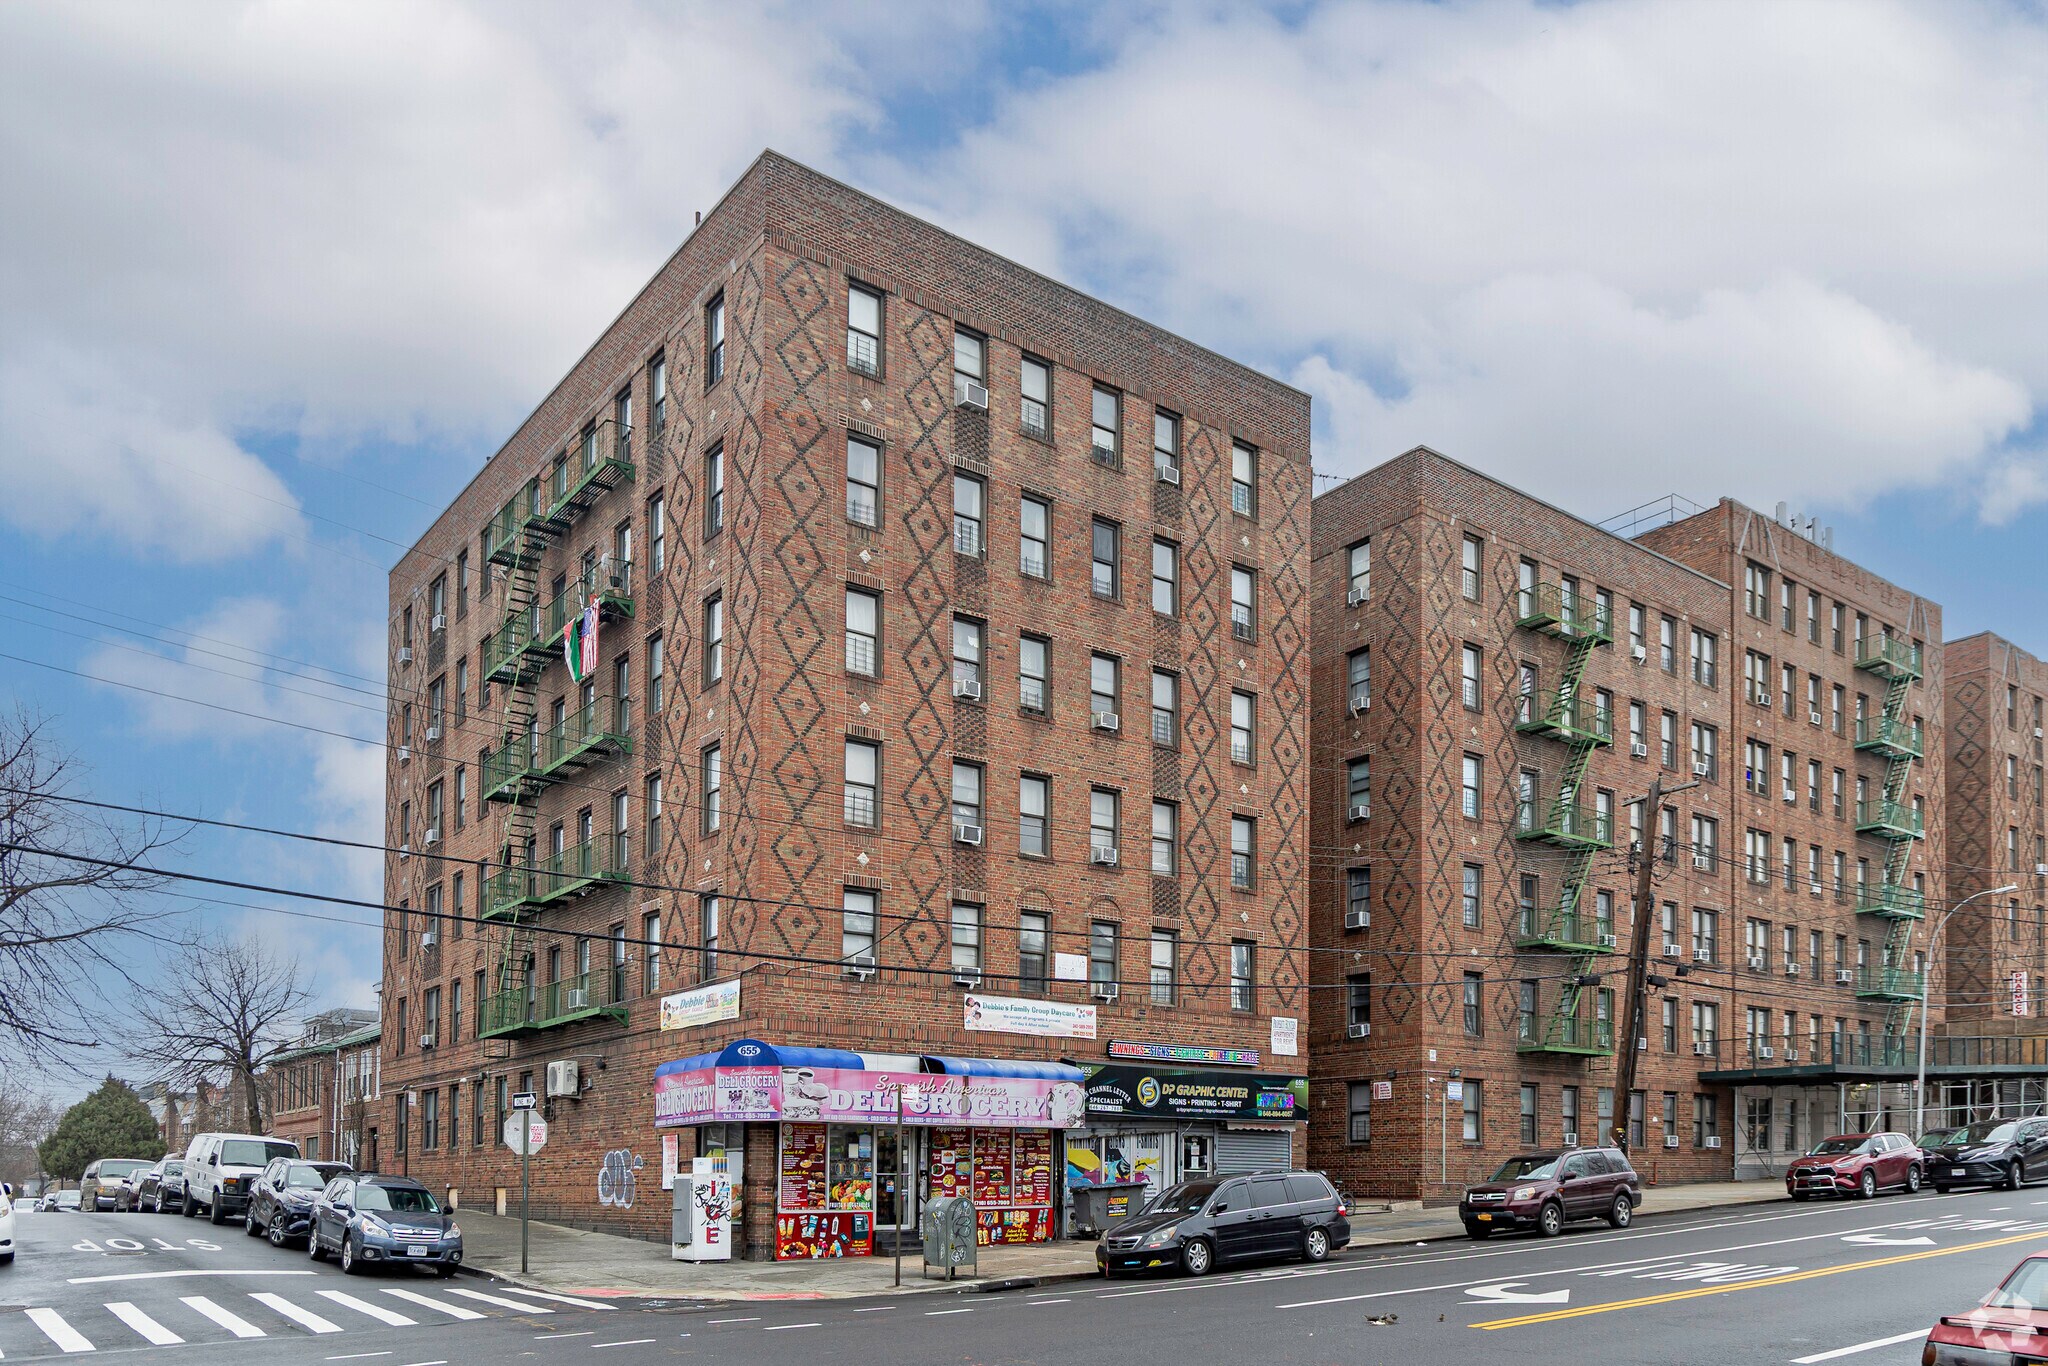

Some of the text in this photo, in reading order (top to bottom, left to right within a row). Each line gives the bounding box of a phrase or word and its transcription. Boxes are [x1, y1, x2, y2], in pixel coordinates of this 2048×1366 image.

[680, 996, 705, 1009] Debbie
[982, 1002, 1075, 1018] Debbie's Family Group Daycare
[740, 1046, 757, 1055] 655
[1112, 1043, 1144, 1056] AWNINGS
[1150, 1046, 1170, 1056] SIGNS
[1176, 1048, 1204, 1060] T-SHIRTS
[1080, 1066, 1092, 1074] 655
[719, 1076, 779, 1088] DELI GROCERY
[876, 1075, 937, 1097] Spish
[941, 1078, 1007, 1096] American
[1088, 1086, 1132, 1103] CHANNEL LETTER
[1162, 1084, 1248, 1099] DP GRAPHIC CENTER
[656, 1084, 714, 1116] DELI GROCERY
[830, 1090, 898, 1112] DELI
[908, 1090, 1045, 1117] GROCERY
[1090, 1096, 1123, 1105] SPECIALIST
[1169, 1098, 1187, 1106] SIGNS
[1190, 1099, 1217, 1107] PRINTING
[72, 1238, 222, 1252] STOP
